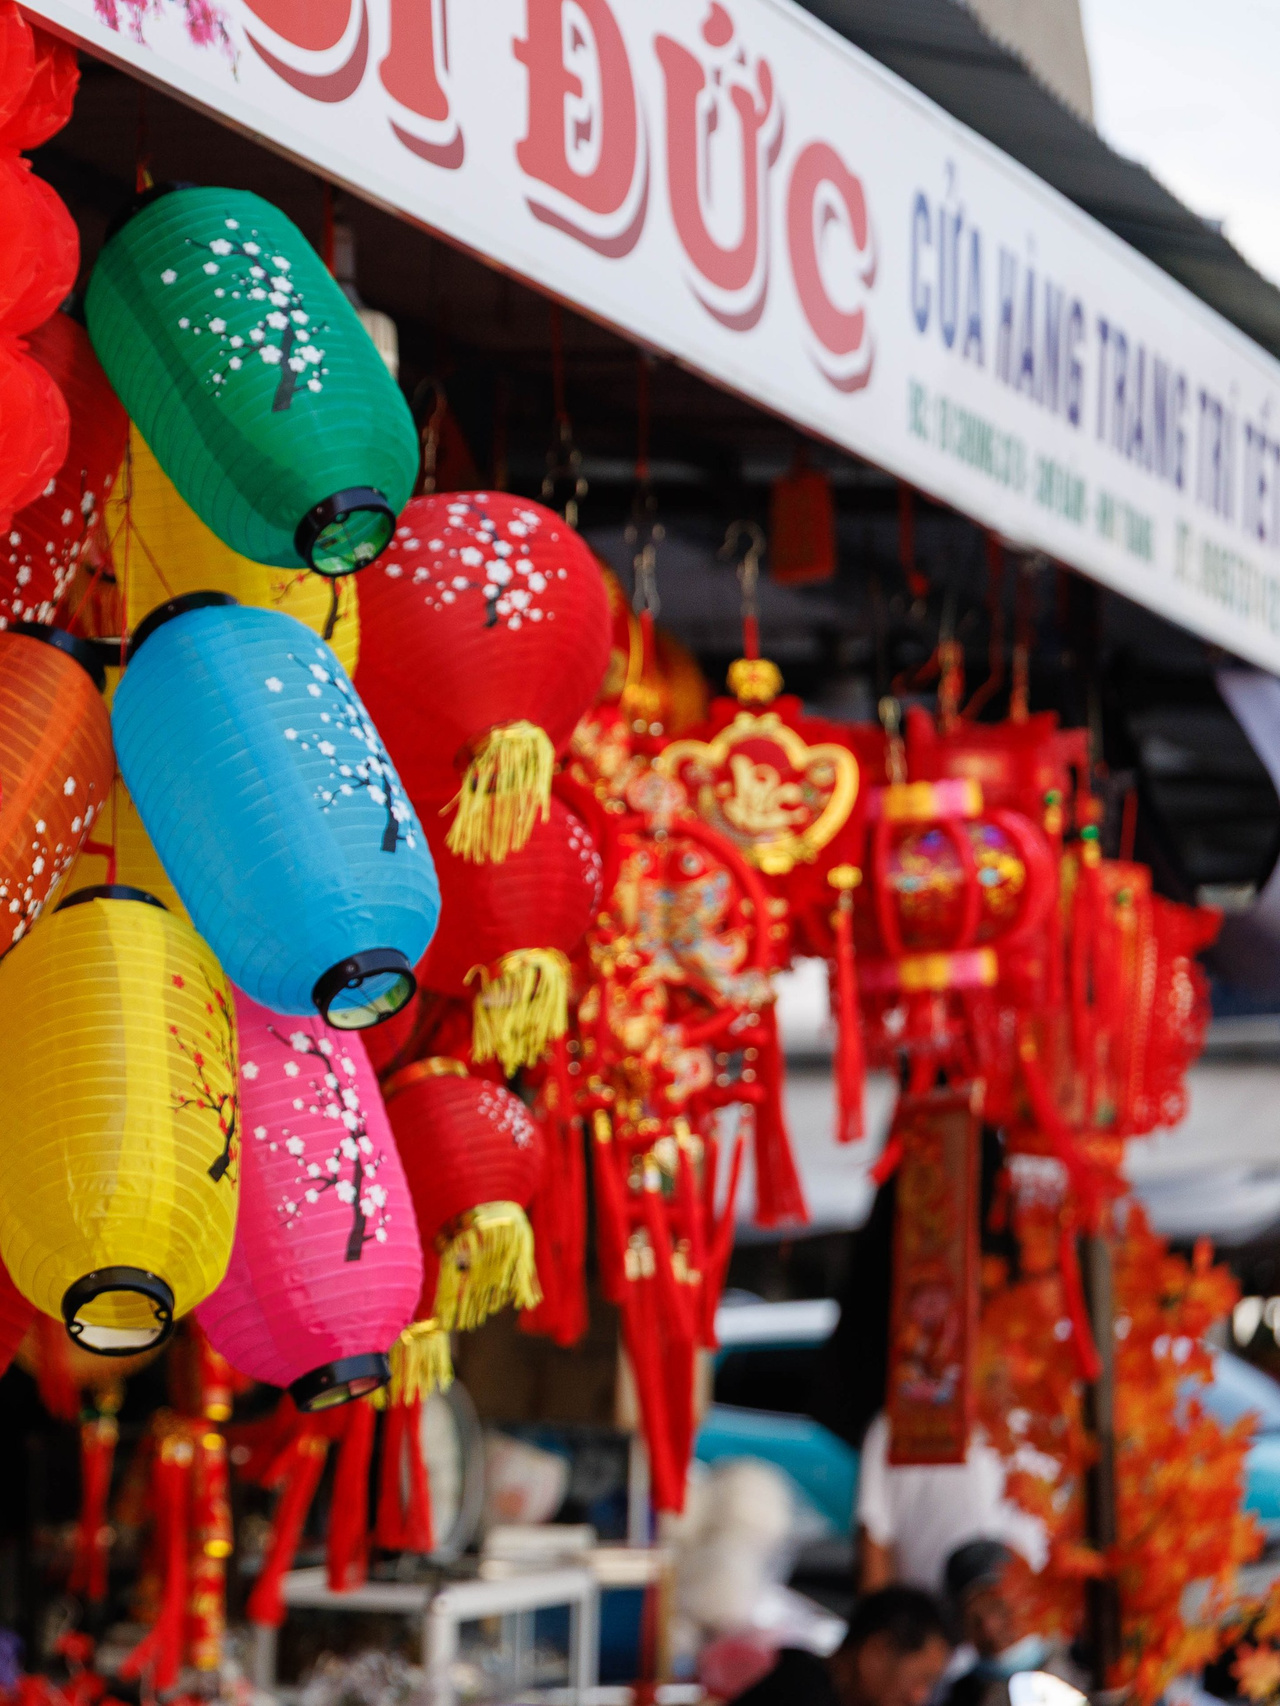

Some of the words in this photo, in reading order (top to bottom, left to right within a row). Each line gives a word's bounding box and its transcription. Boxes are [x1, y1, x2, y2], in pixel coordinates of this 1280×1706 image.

[513, 0, 875, 392] ĐỨC
[909, 158, 985, 367] CỬA
[996, 230, 1084, 429] HÀNG
[1094, 312, 1189, 492] TRANG
